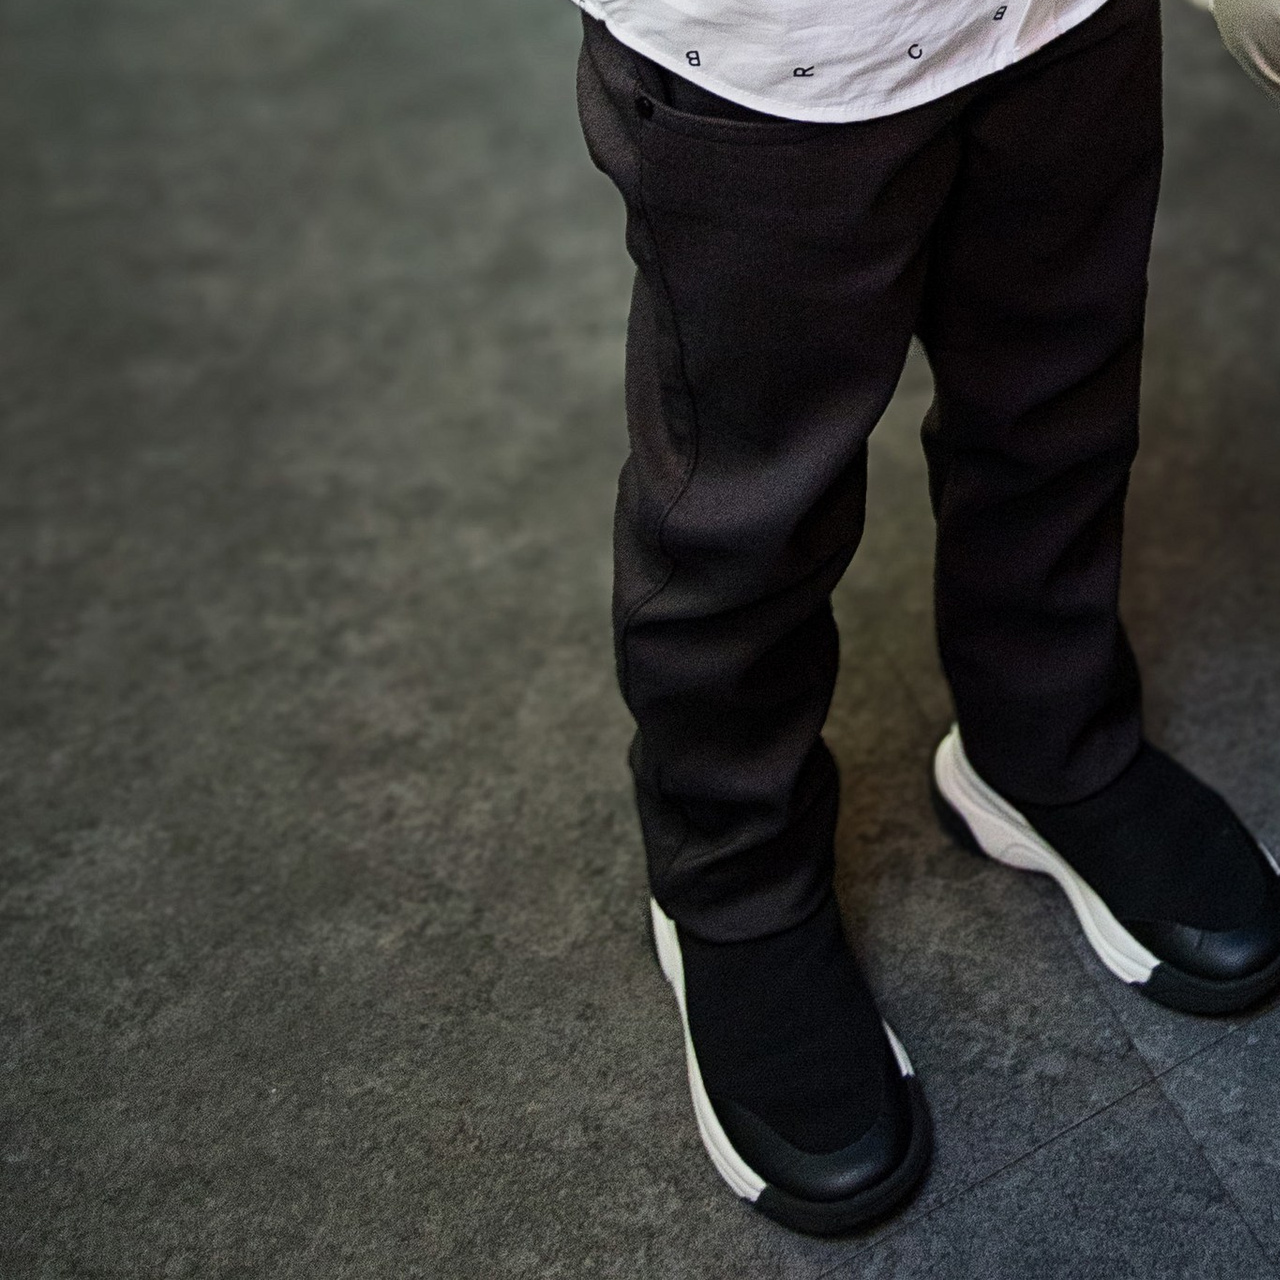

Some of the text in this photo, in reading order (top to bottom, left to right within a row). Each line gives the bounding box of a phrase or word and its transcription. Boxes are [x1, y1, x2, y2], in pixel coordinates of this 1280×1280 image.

[685, 50, 701, 67] B
[907, 43, 923, 59] C
[793, 65, 815, 78] R
